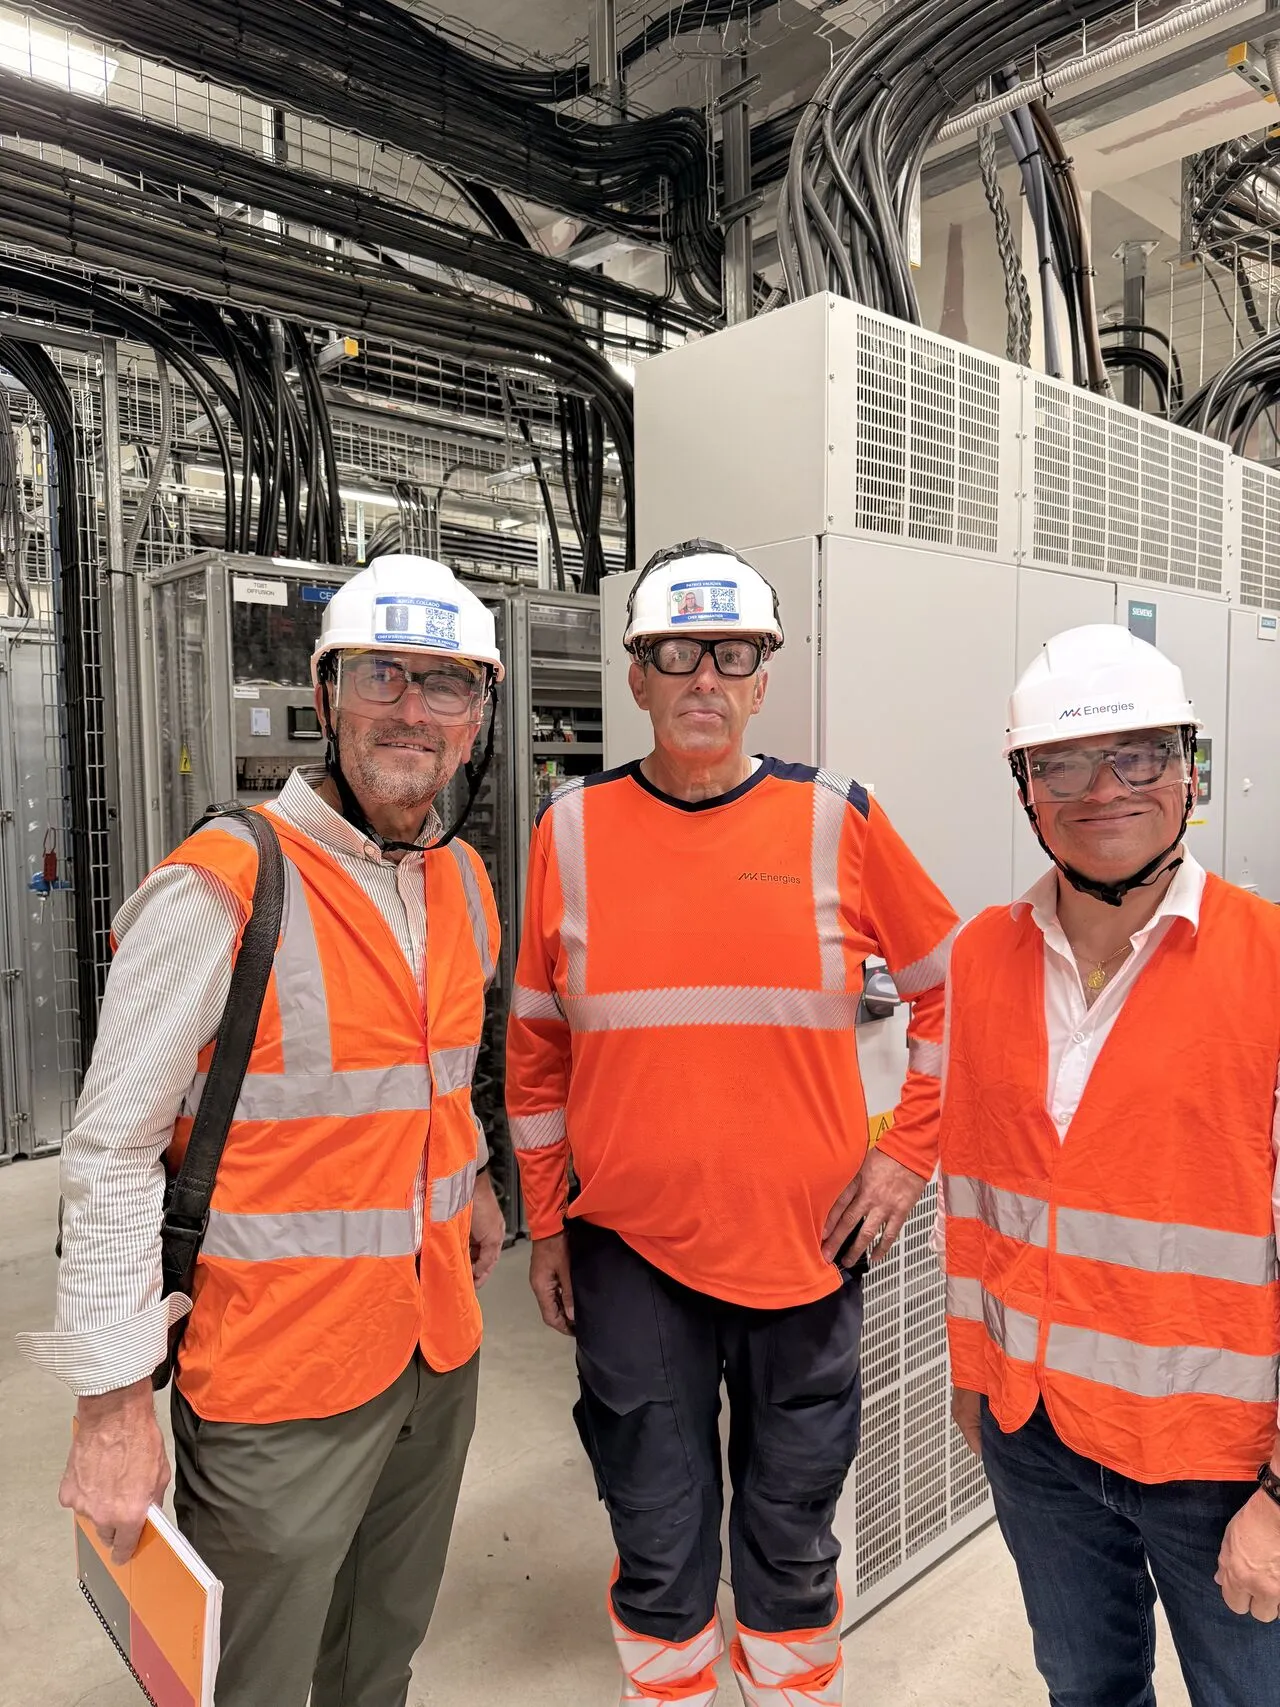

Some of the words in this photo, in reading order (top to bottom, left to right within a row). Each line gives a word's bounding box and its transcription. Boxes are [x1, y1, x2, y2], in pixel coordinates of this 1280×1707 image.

[247, 588, 275, 596] DIFFUSION
[416, 600, 440, 608] COLLADO
[1132, 607, 1153, 617] SIEMENS
[1083, 702, 1135, 716] Energies
[760, 872, 801, 884] Energies
